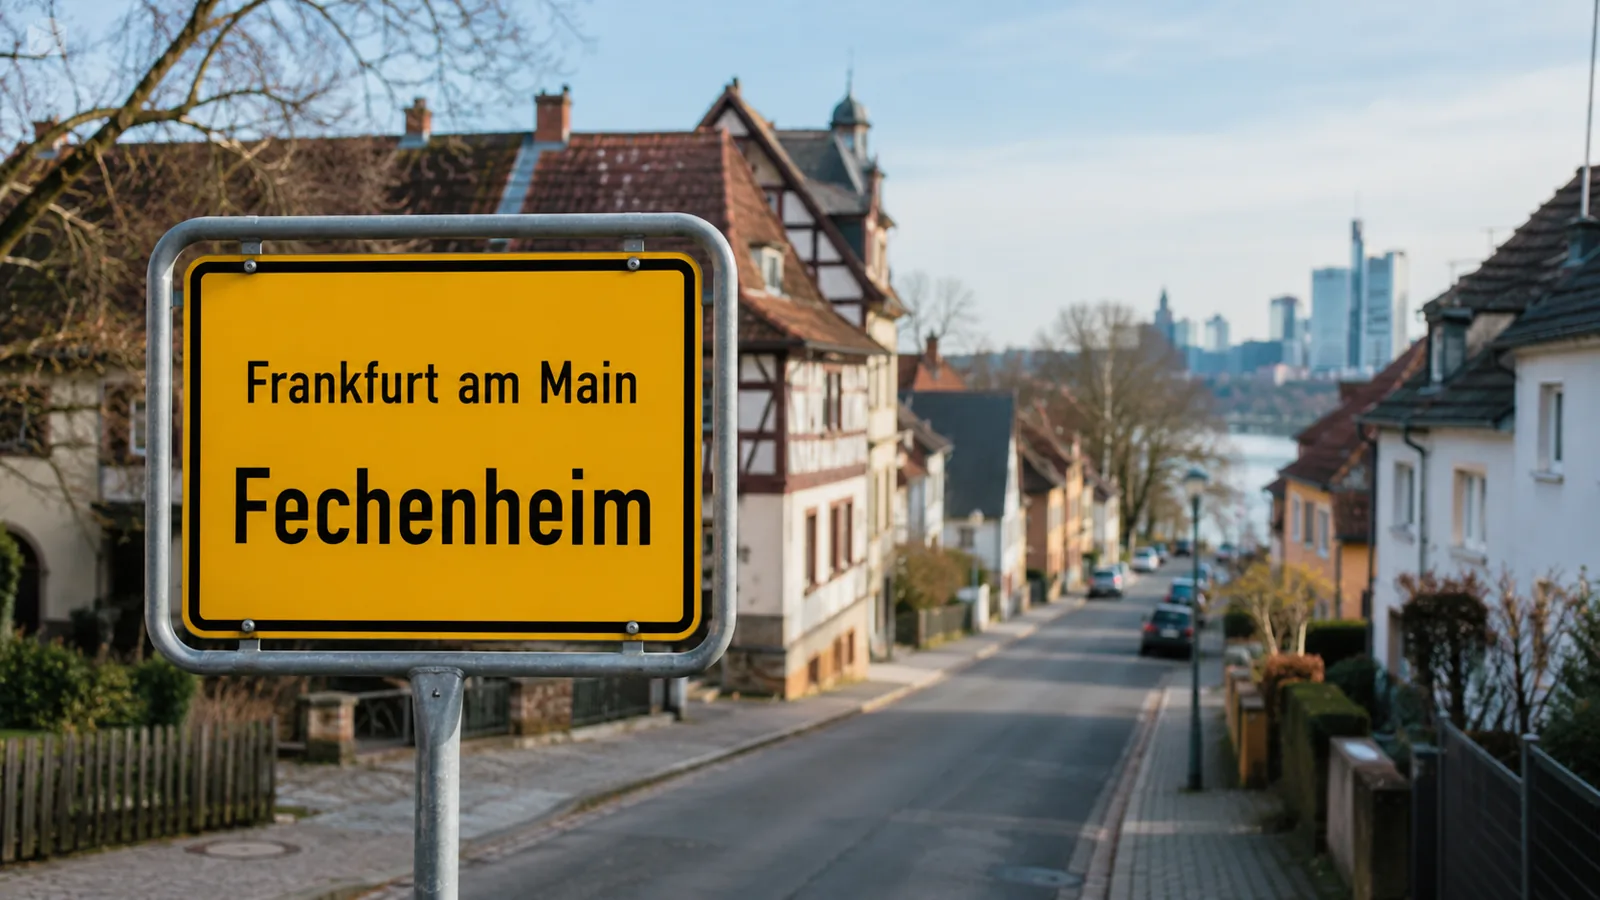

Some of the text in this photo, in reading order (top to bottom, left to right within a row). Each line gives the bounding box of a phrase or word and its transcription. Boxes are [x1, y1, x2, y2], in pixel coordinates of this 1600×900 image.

[247, 360, 637, 404] Frankfurt am Main
[235, 467, 651, 545] Fechenheim
